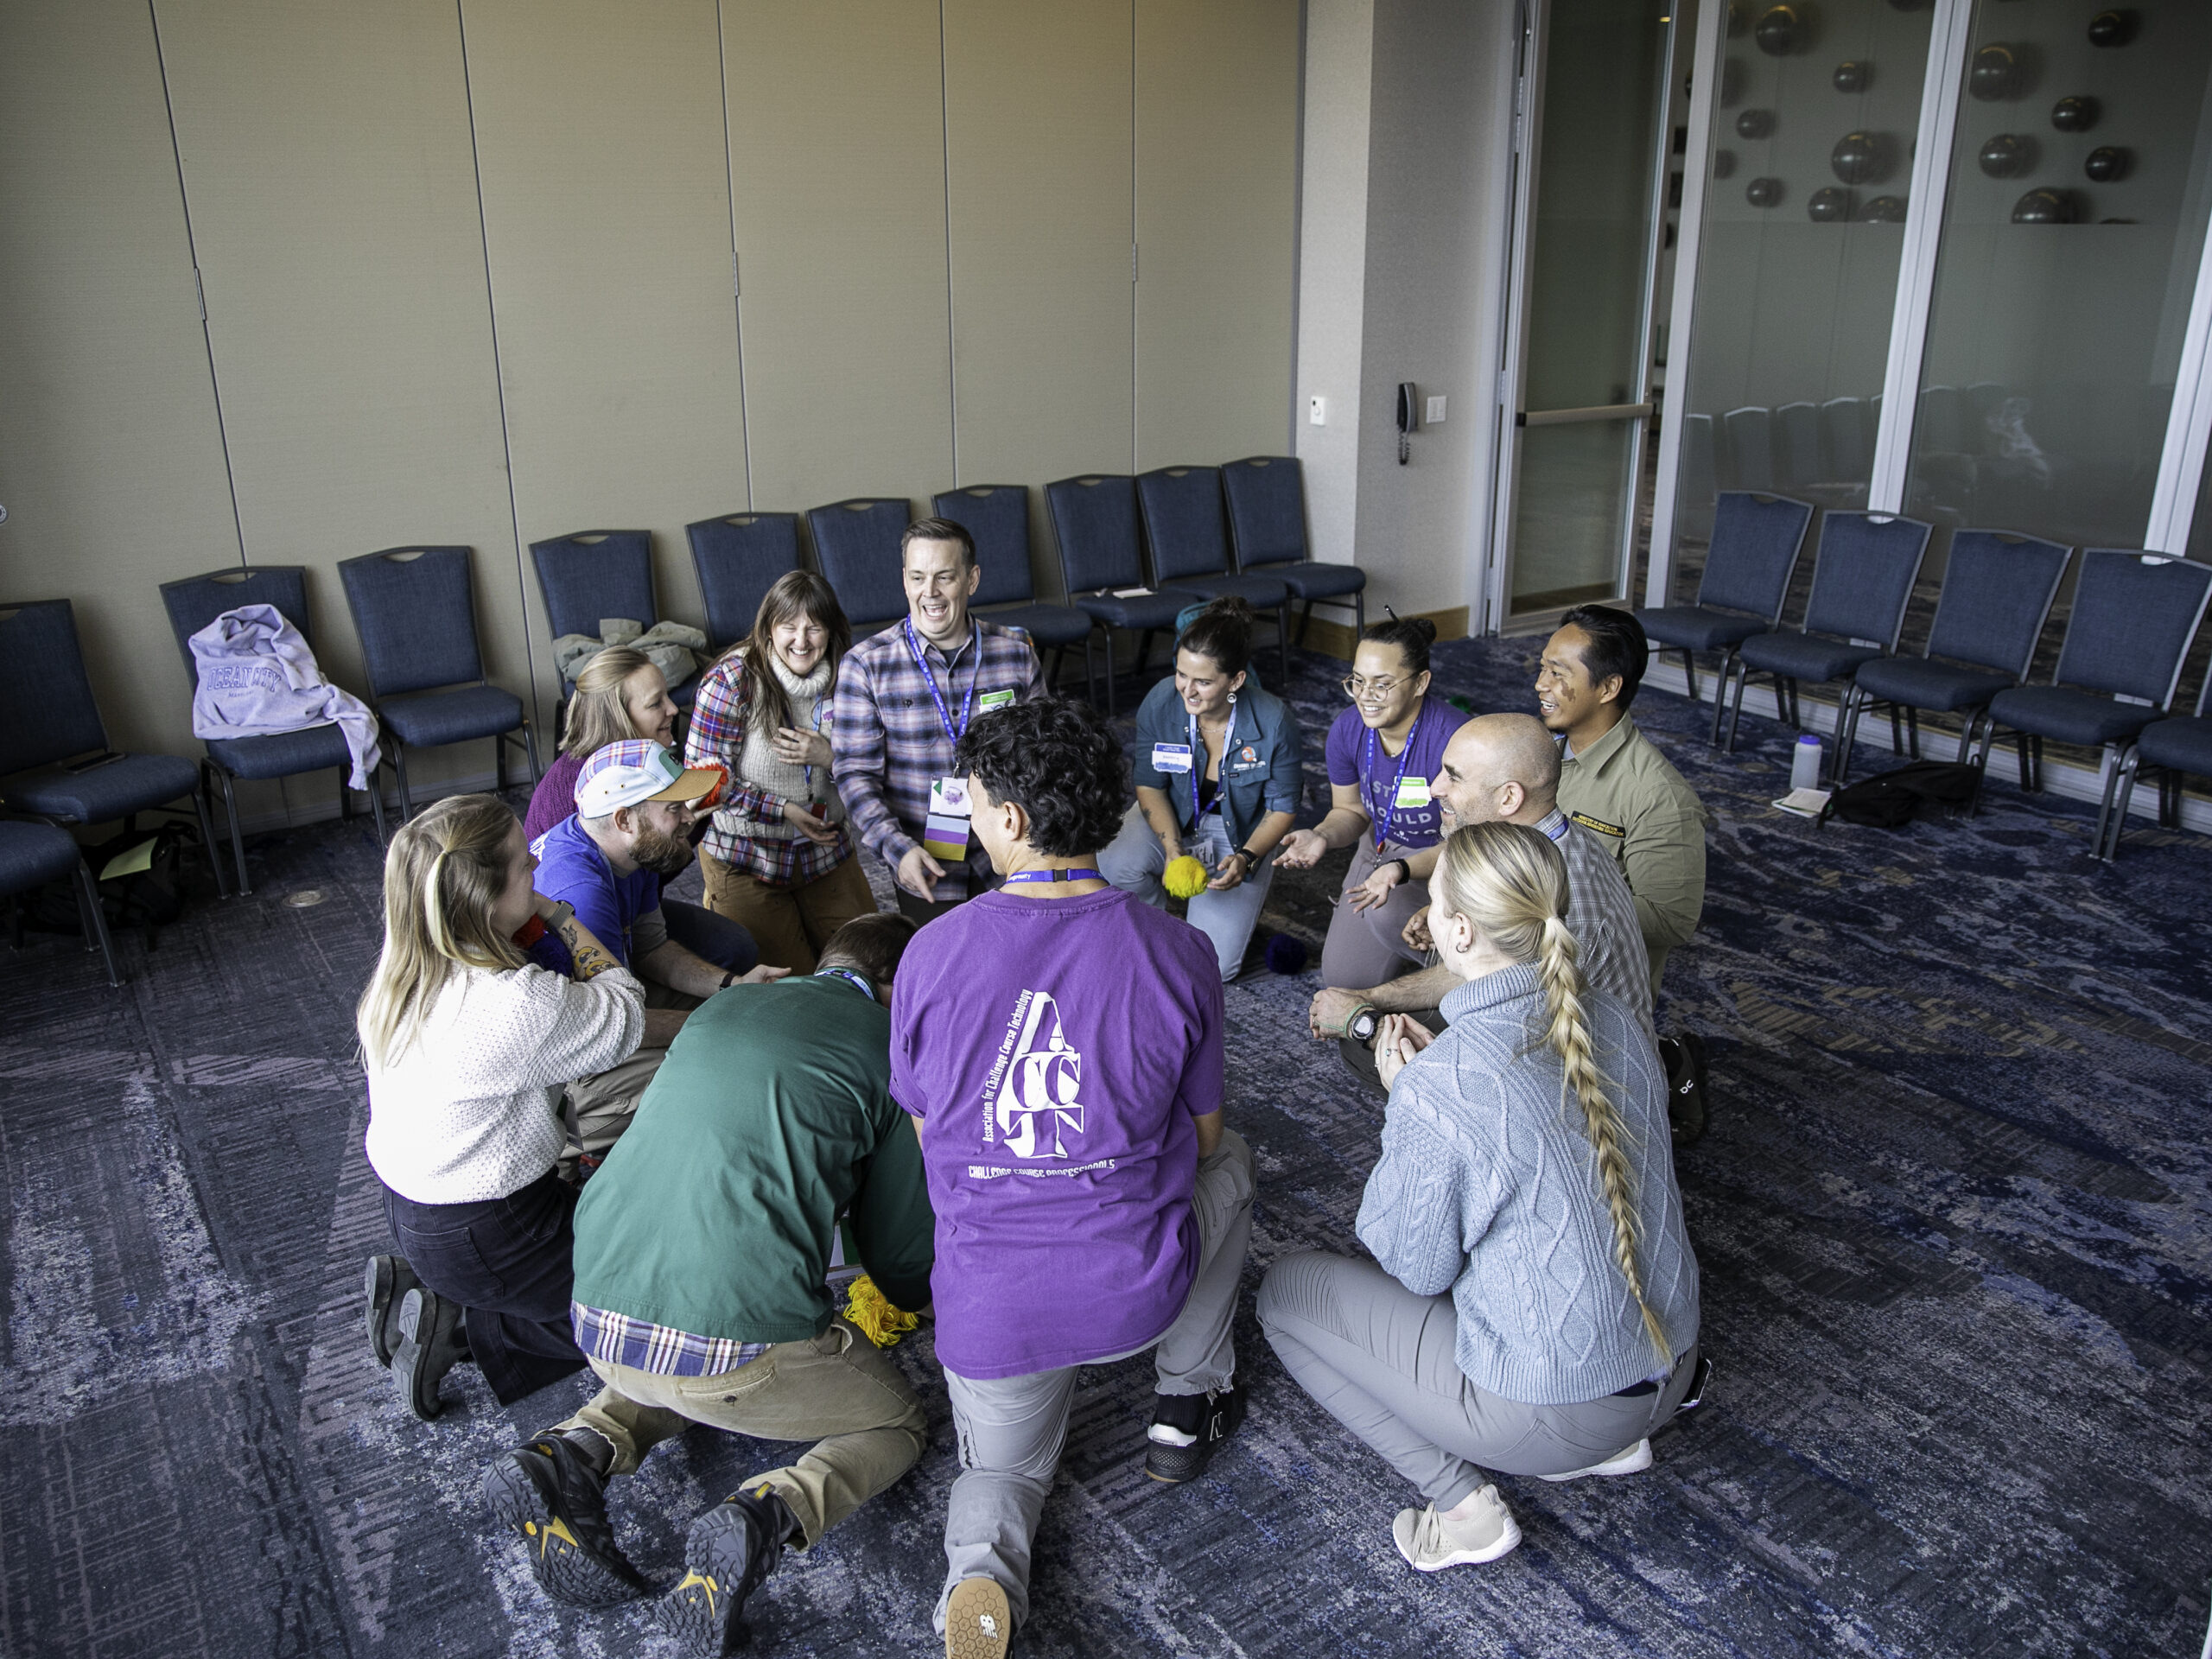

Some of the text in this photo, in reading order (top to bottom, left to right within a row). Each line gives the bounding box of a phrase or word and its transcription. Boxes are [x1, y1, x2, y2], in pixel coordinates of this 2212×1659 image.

[207, 665, 249, 691] OCEAN
[981, 988, 1034, 1143] Association for Challenge Course Technology
